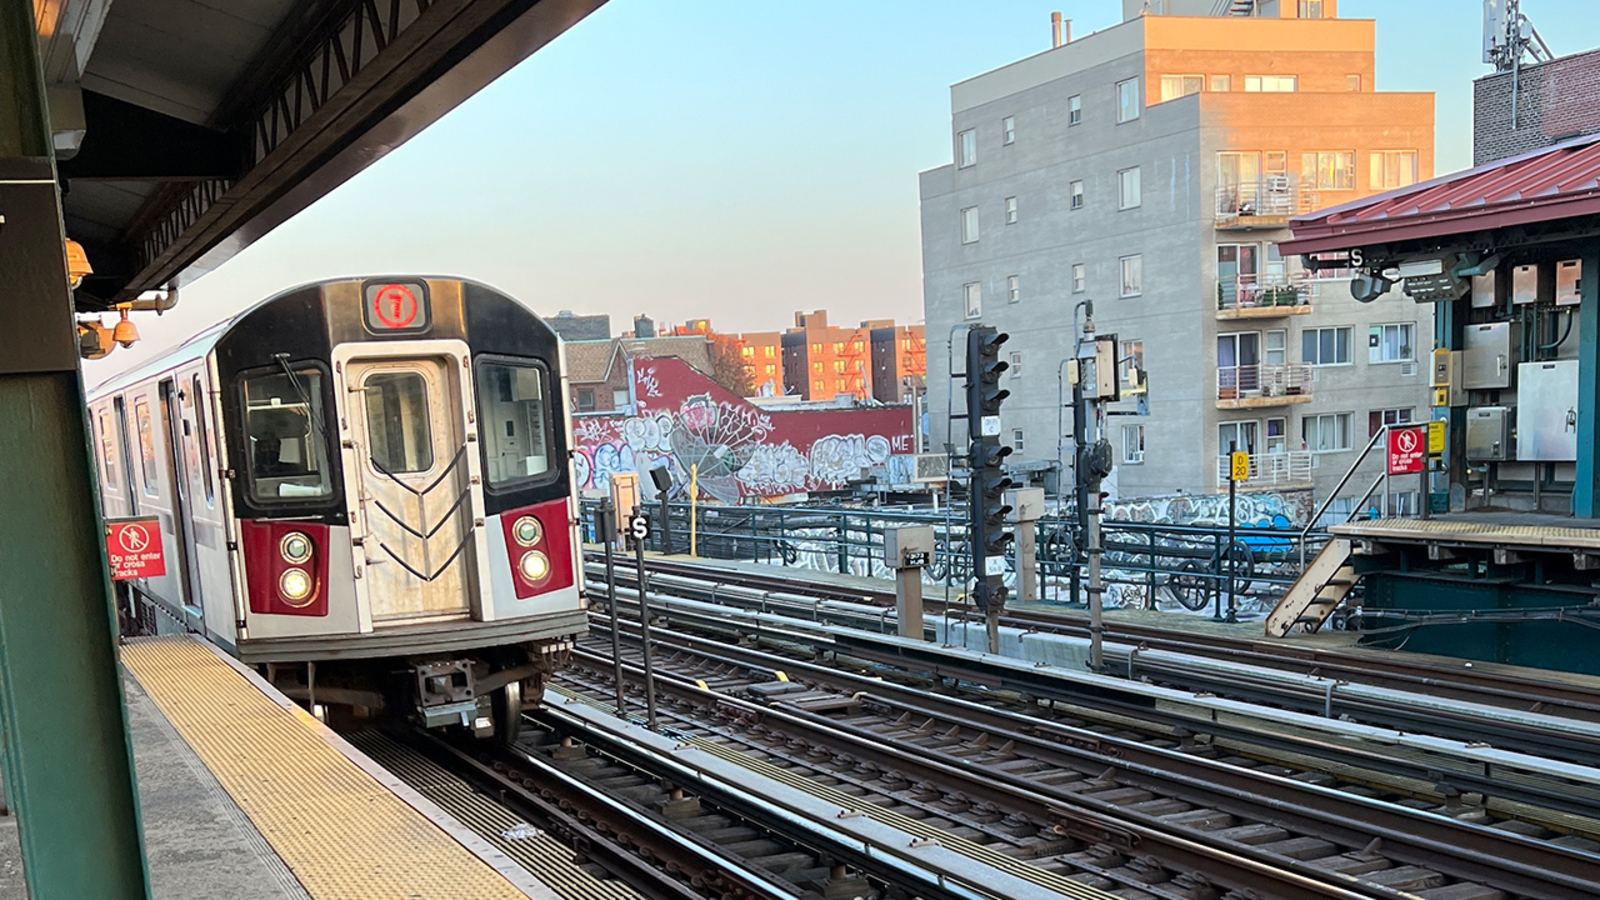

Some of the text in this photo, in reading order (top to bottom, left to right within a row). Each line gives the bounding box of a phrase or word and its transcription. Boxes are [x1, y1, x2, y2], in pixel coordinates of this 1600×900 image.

[1351, 249, 1363, 267] S
[387, 294, 403, 320] 7
[891, 434, 914, 451] ME
[1235, 466, 1246, 476] 20
[632, 516, 648, 538] S
[111, 554, 123, 562] Do
[140, 552, 160, 560] enter
[123, 560, 146, 568] cross
[113, 568, 138, 577] racks
